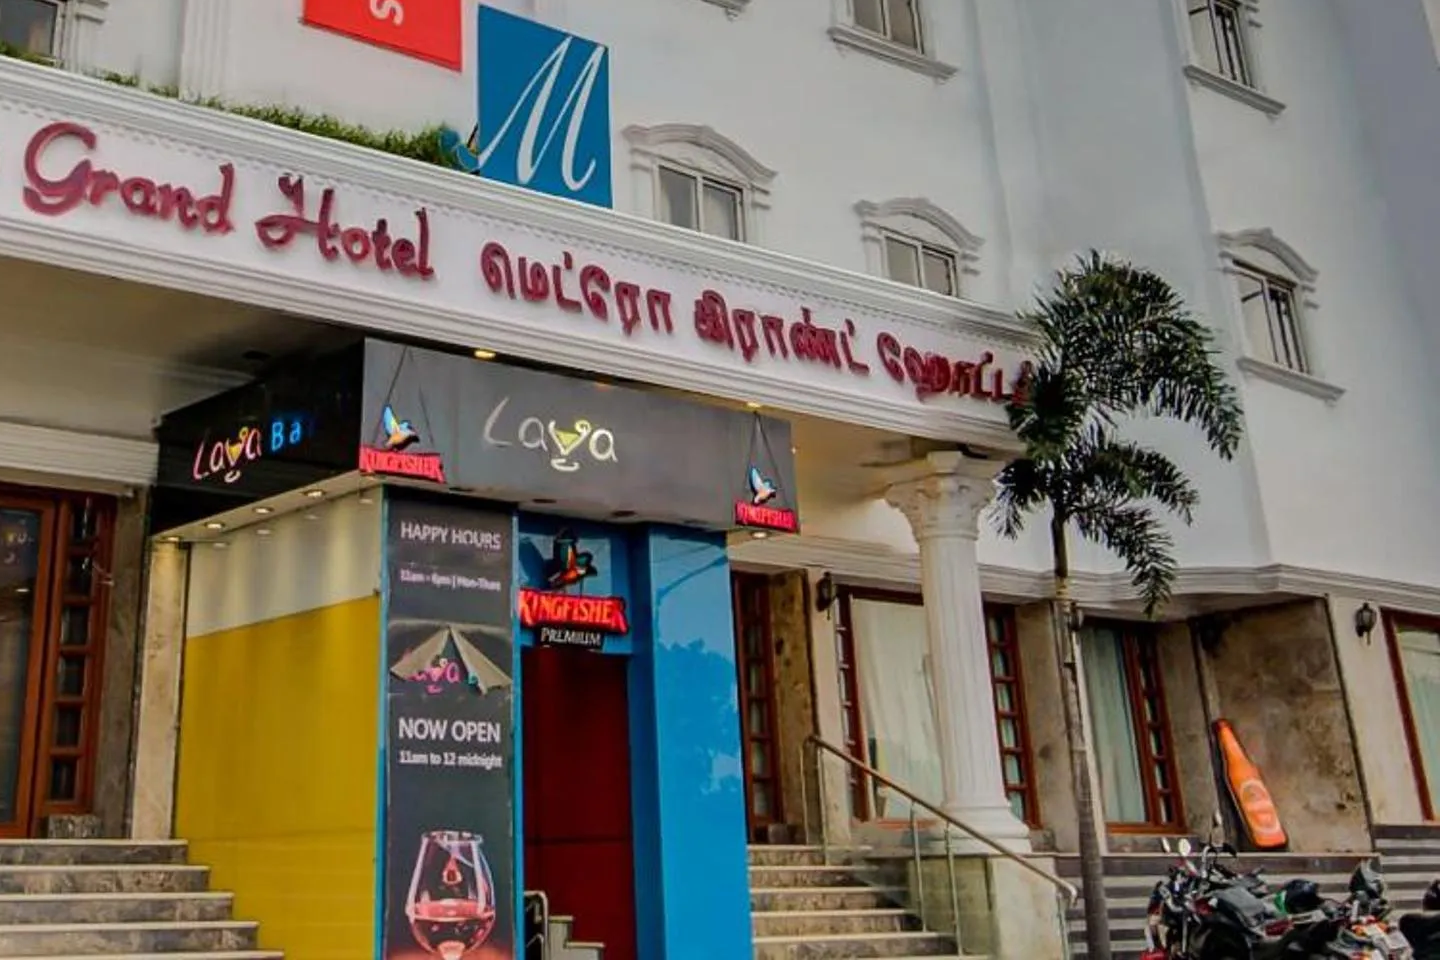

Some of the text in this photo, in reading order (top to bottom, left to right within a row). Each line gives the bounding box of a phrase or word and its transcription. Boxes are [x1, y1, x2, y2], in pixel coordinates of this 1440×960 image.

[22, 120, 235, 234] Grand
[255, 172, 435, 281] Hotel
[480, 241, 674, 336] மெட்ரோ
[483, 396, 618, 472] Lava
[193, 426, 261, 483] Lava
[359, 446, 445, 483] KINGFISHER
[400, 521, 502, 550] HAPPY HOURS
[517, 590, 628, 633] KINGFISHER
[541, 627, 601, 646] PREMIUM
[398, 717, 502, 743] NOW OPEN
[429, 752, 442, 765] to
[457, 752, 502, 770] midnight
